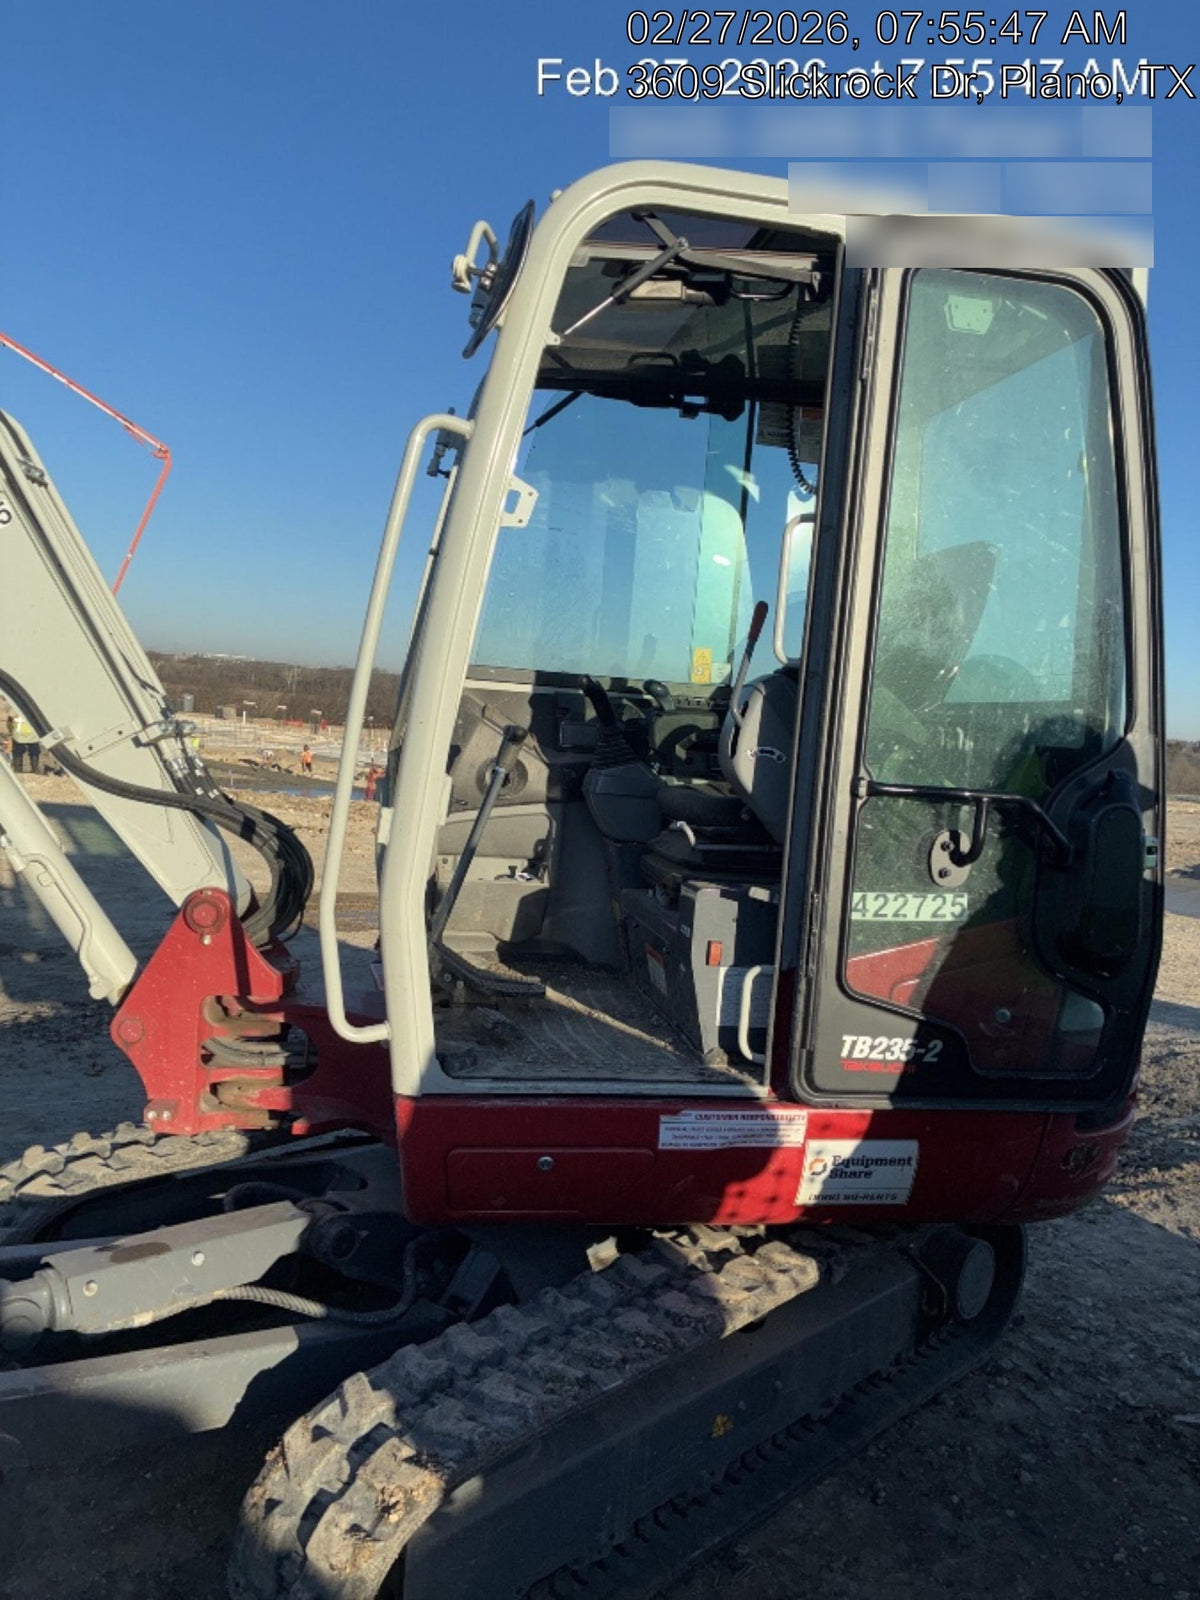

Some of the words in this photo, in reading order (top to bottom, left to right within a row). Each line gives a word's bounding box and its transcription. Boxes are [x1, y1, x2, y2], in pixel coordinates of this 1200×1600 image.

[851, 892, 968, 919] 422725
[840, 1034, 944, 1063] TB235-2
[831, 1155, 913, 1168] Equipment
[829, 1168, 873, 1179] Share
